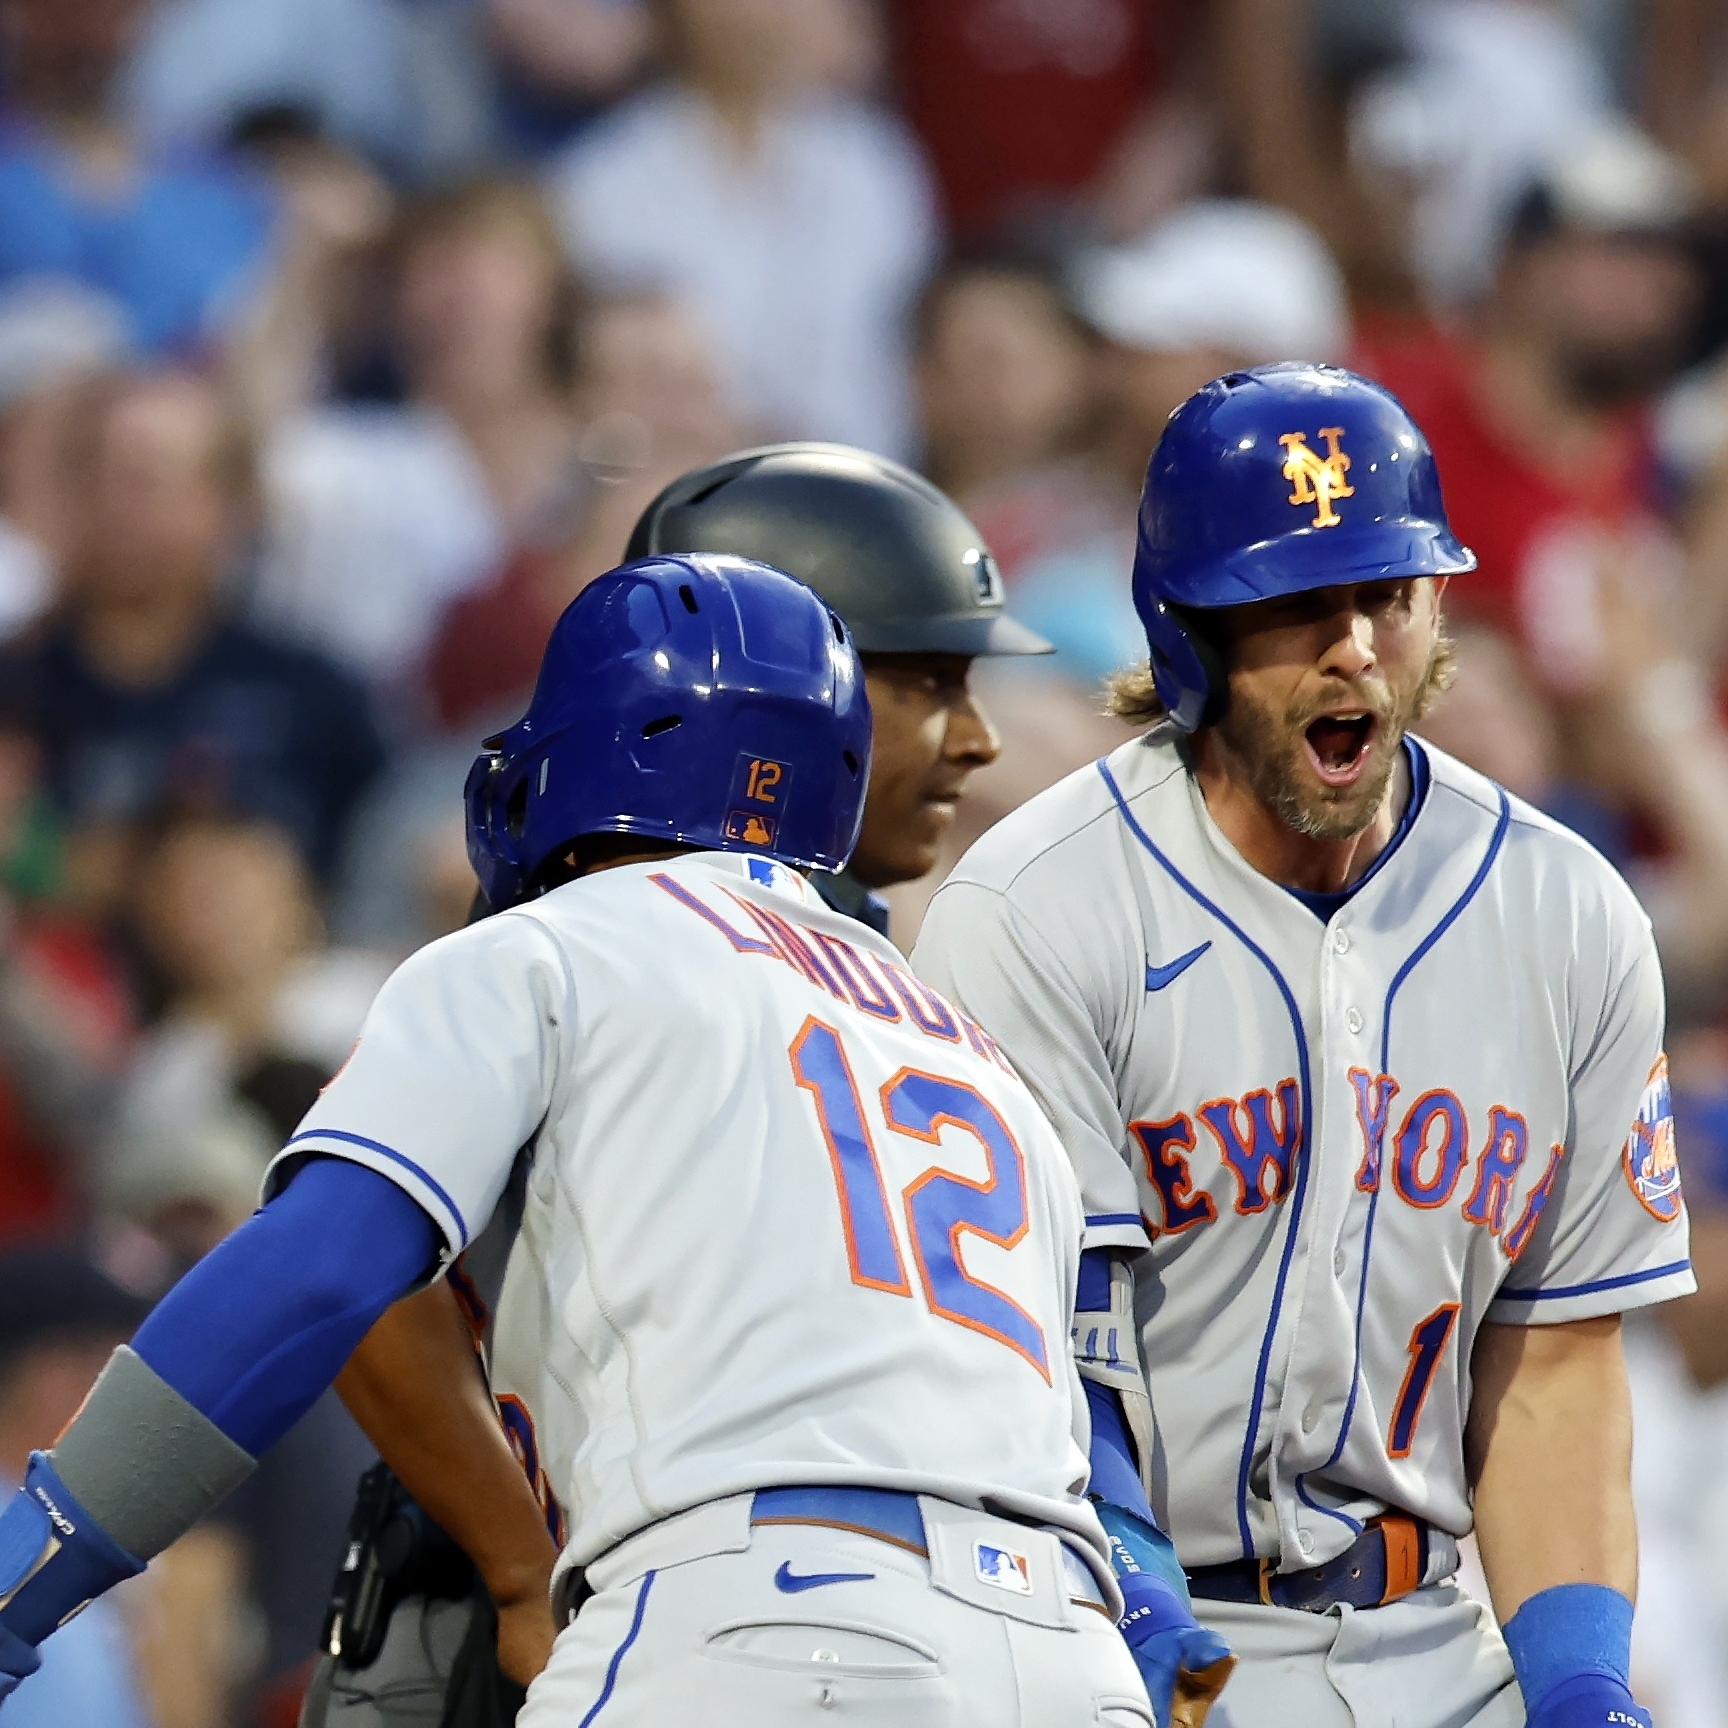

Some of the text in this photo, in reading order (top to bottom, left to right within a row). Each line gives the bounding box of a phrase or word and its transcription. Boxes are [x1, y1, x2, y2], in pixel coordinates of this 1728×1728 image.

[746, 759, 782, 803] 12
[787, 1013, 1054, 1389] 12
[1129, 1077, 1303, 1240] EW
[1386, 1302, 1462, 1459] 1
